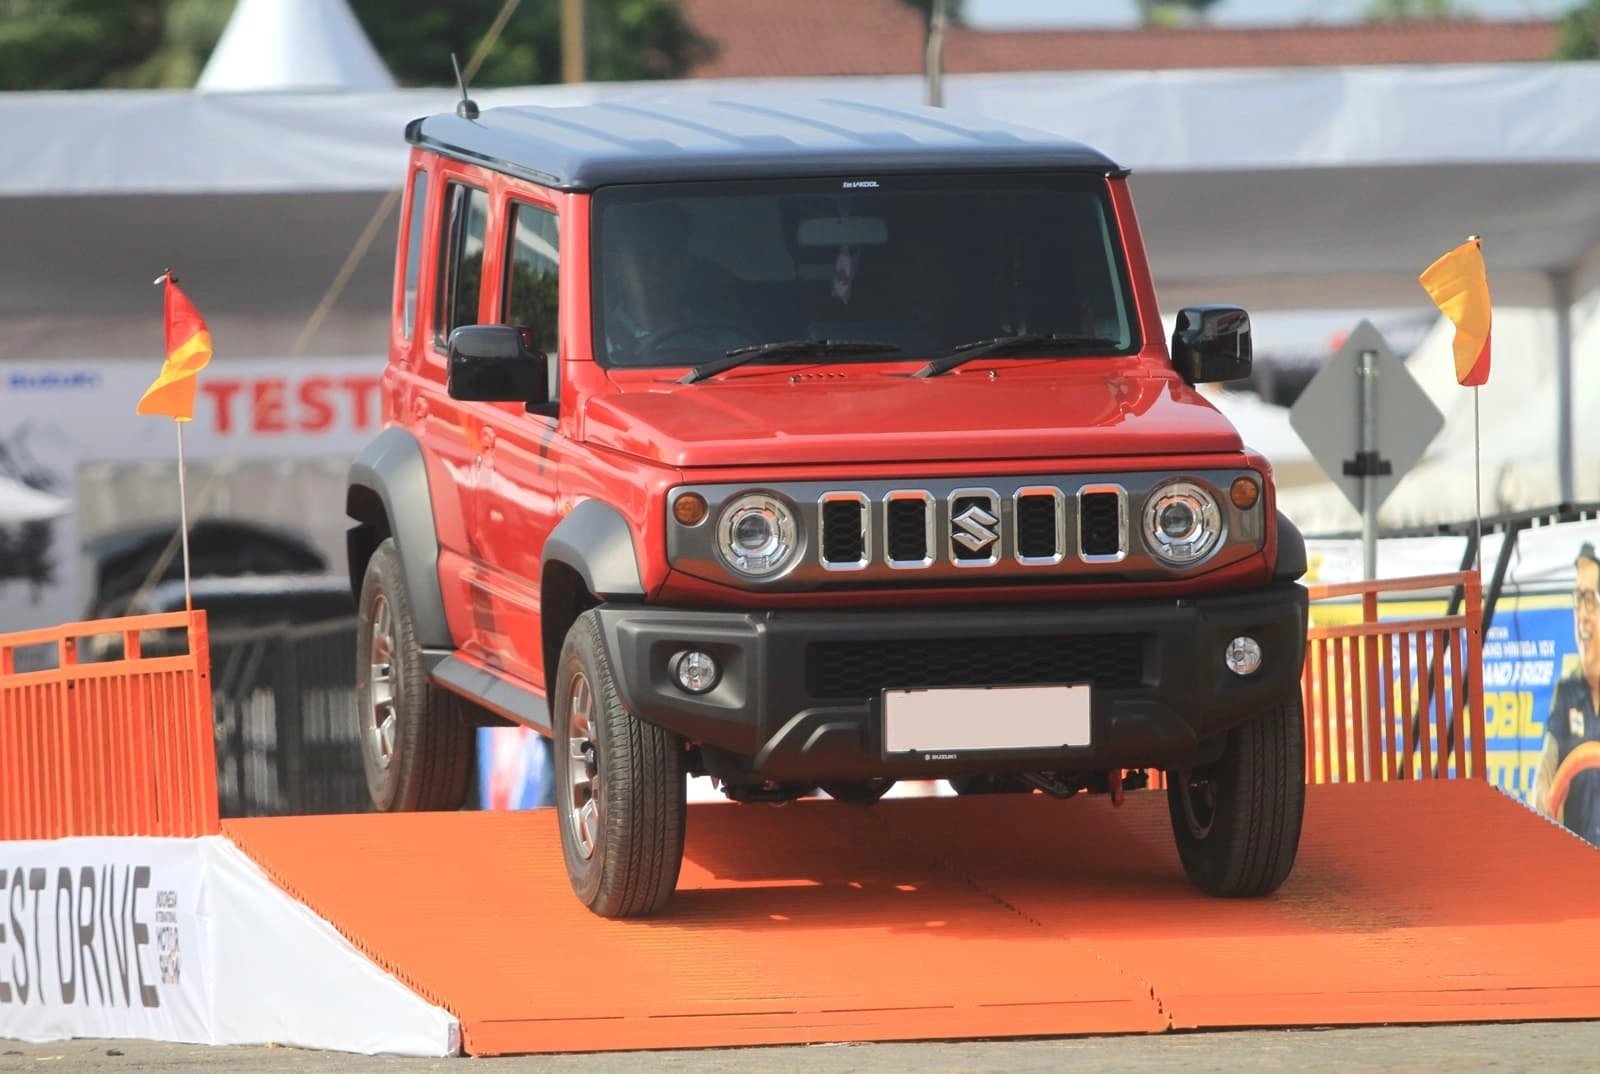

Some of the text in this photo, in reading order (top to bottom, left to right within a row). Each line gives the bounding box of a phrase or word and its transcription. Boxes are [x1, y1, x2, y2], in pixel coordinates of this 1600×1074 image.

[201, 378, 381, 434] TEST
[1482, 661, 1512, 686] AND
[1484, 691, 1544, 739] OBIL
[56, 864, 160, 1008] DRIVE
